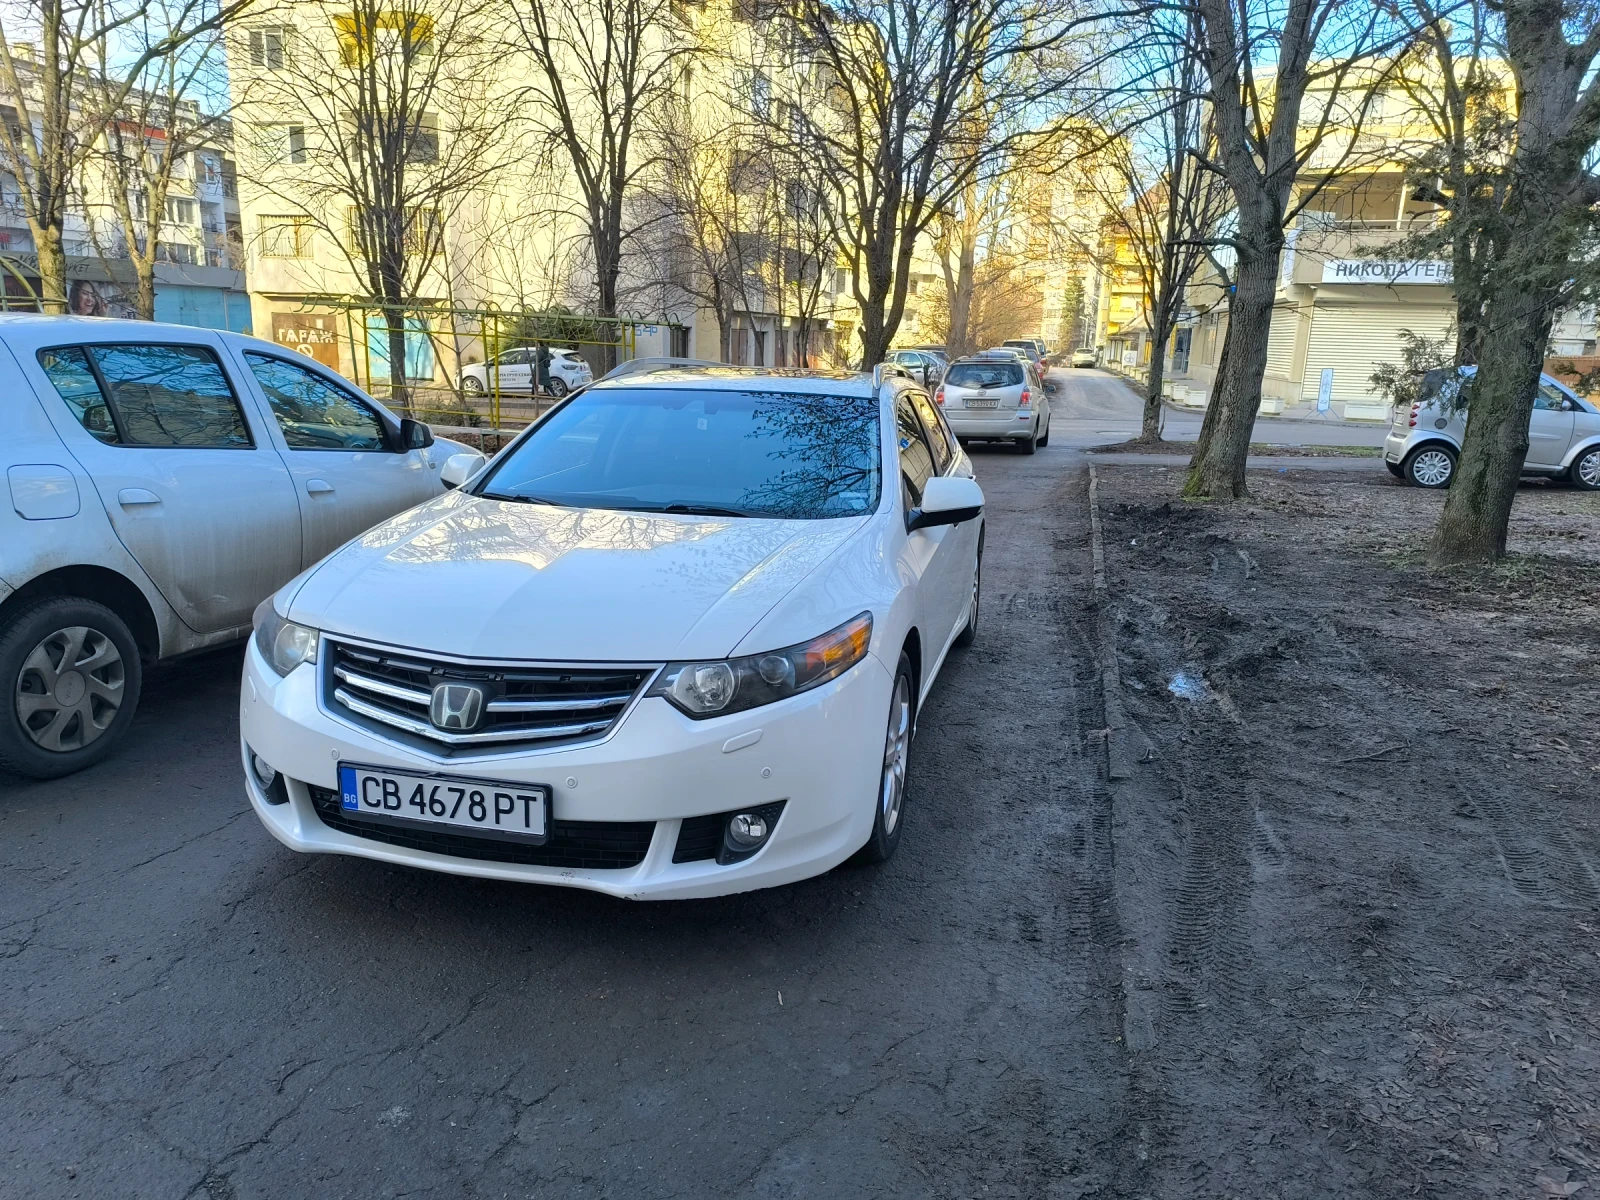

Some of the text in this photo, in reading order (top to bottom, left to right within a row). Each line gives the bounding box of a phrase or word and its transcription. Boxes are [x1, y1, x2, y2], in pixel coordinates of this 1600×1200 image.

[278, 328, 334, 344] ГАРАЖ
[344, 793, 357, 804] BG
[409, 783, 487, 822] 4678
[494, 792, 537, 828] PT
